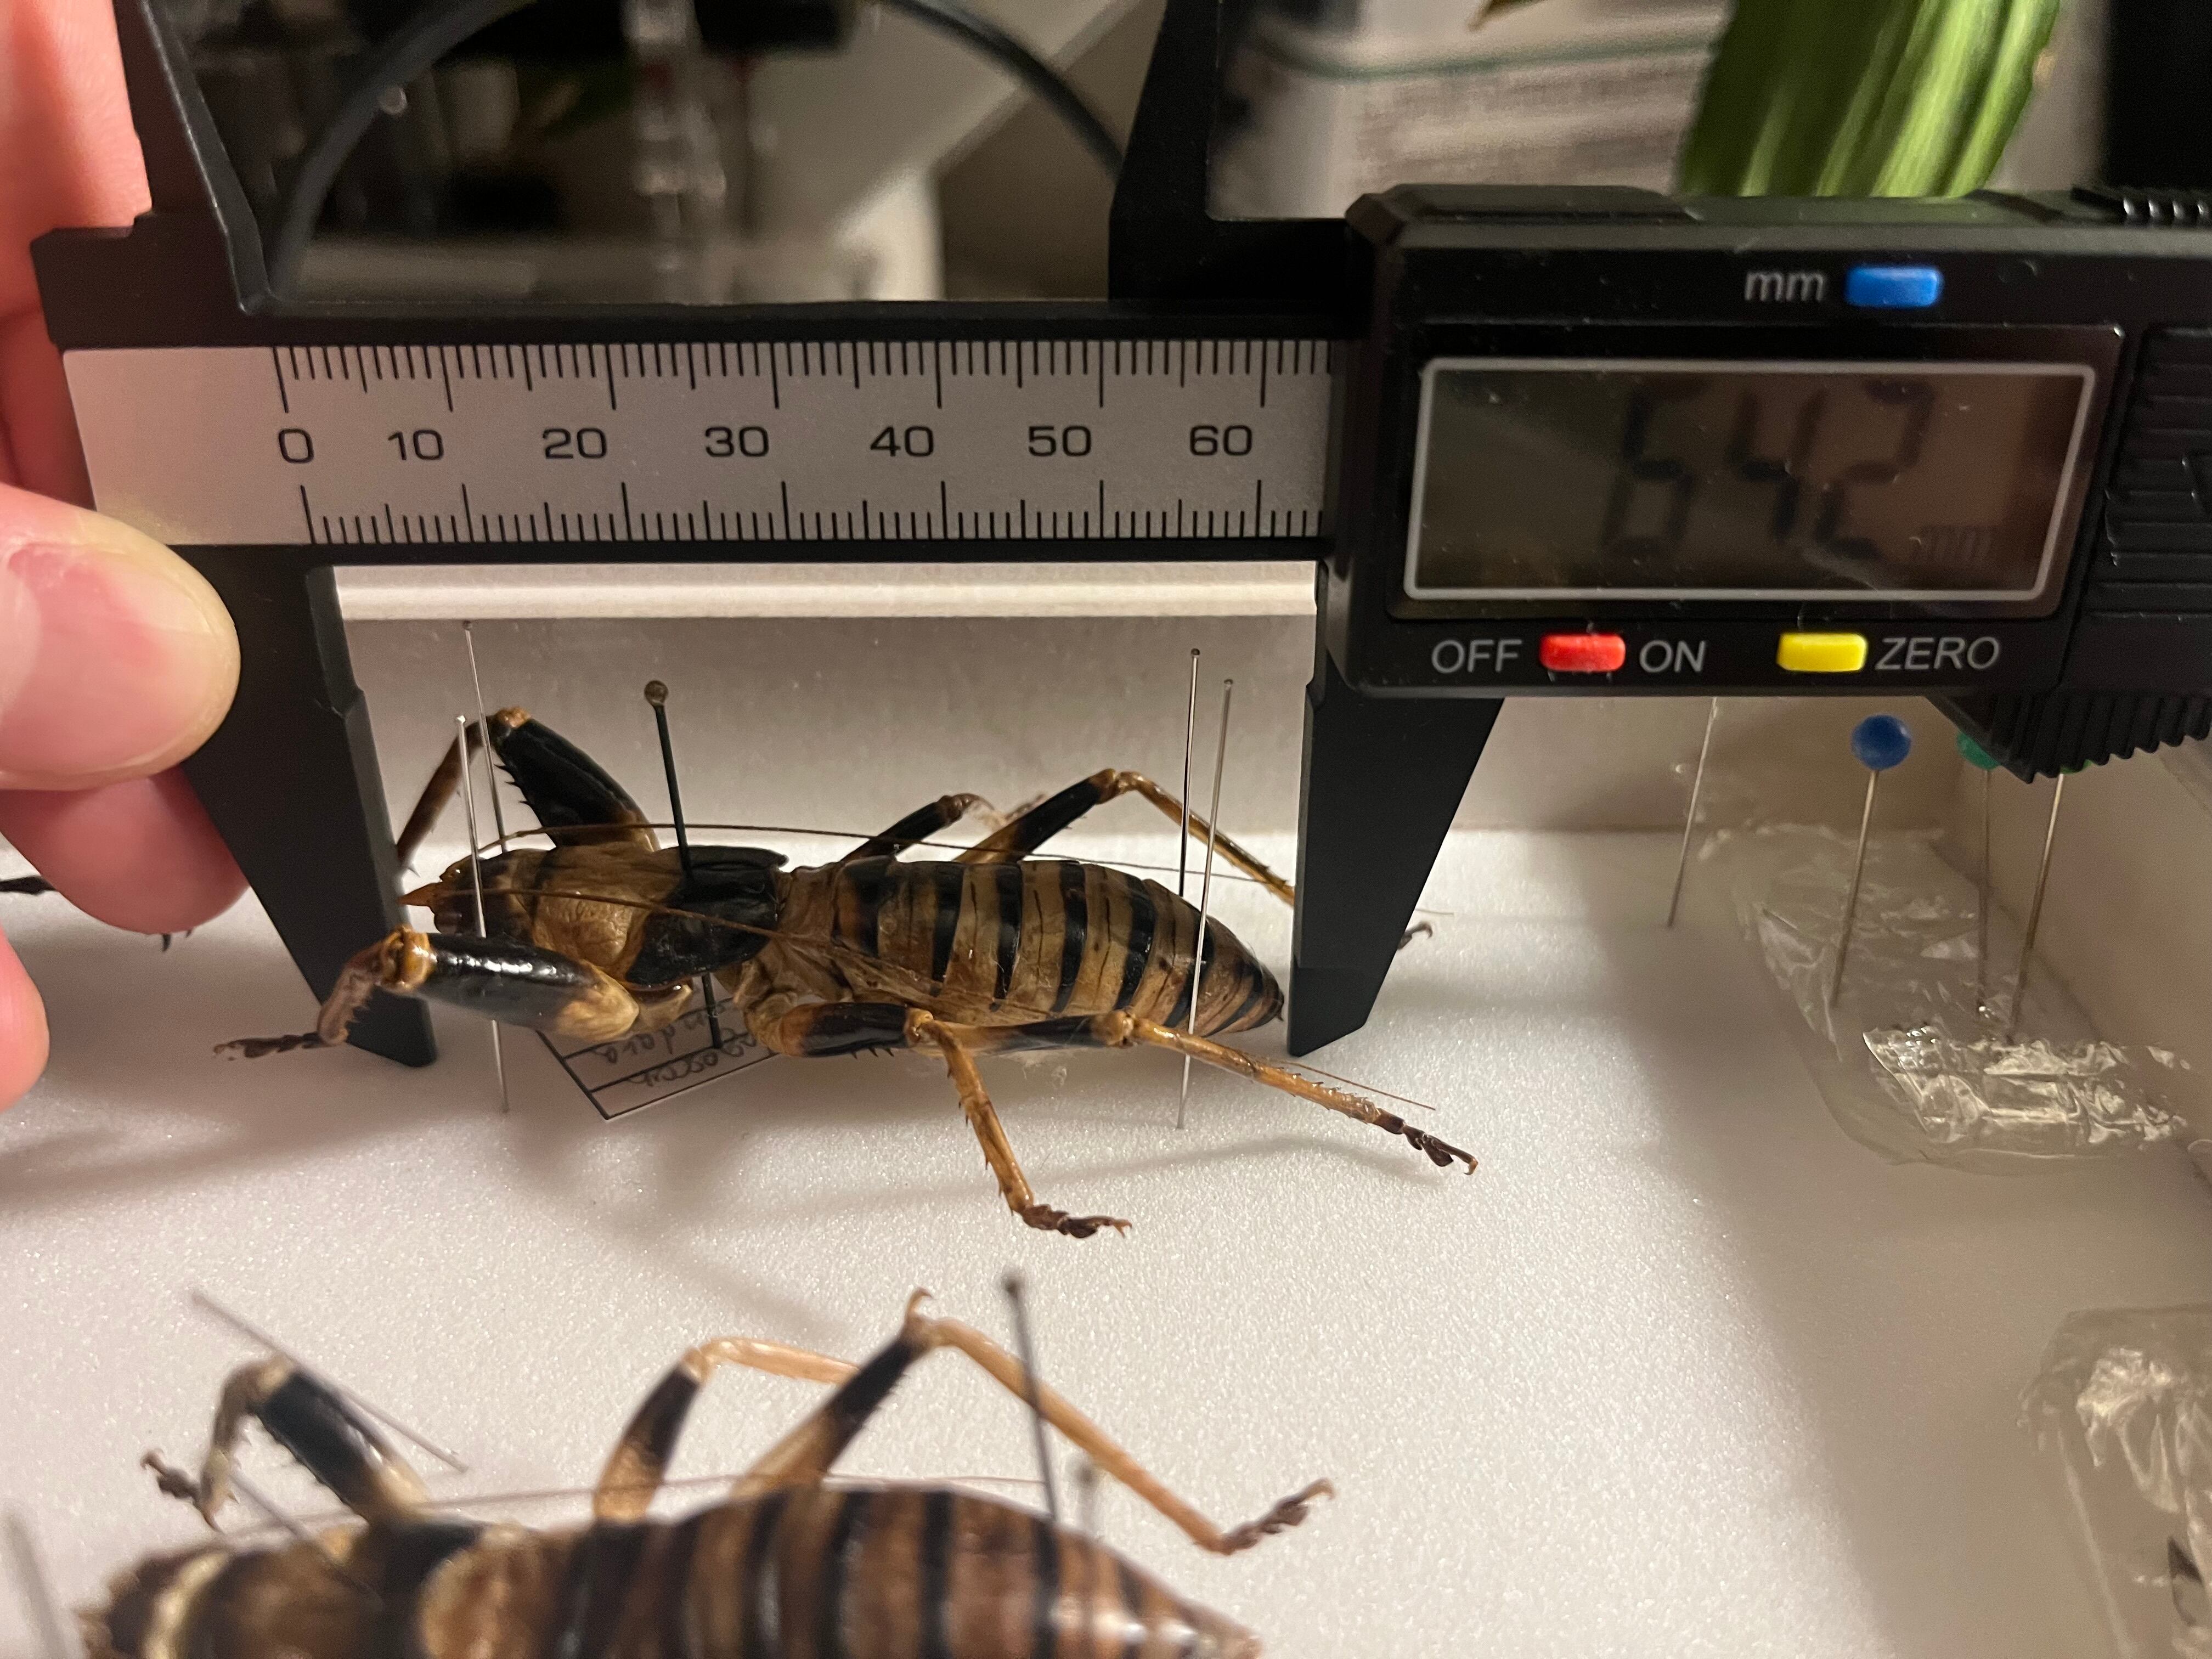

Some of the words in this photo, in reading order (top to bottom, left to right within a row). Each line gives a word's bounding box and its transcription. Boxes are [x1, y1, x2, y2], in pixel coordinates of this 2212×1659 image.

[1745, 271, 1824, 302] mm
[277, 428, 314, 464] 0
[387, 428, 445, 461] 10
[542, 427, 608, 460] 20
[704, 426, 770, 459] 30
[869, 425, 935, 458] 40
[1028, 425, 1092, 457] 50
[1188, 424, 1253, 456] 60
[1431, 638, 1523, 674] OFF
[1638, 639, 1707, 674] ON
[1874, 636, 2000, 671] ZERO
